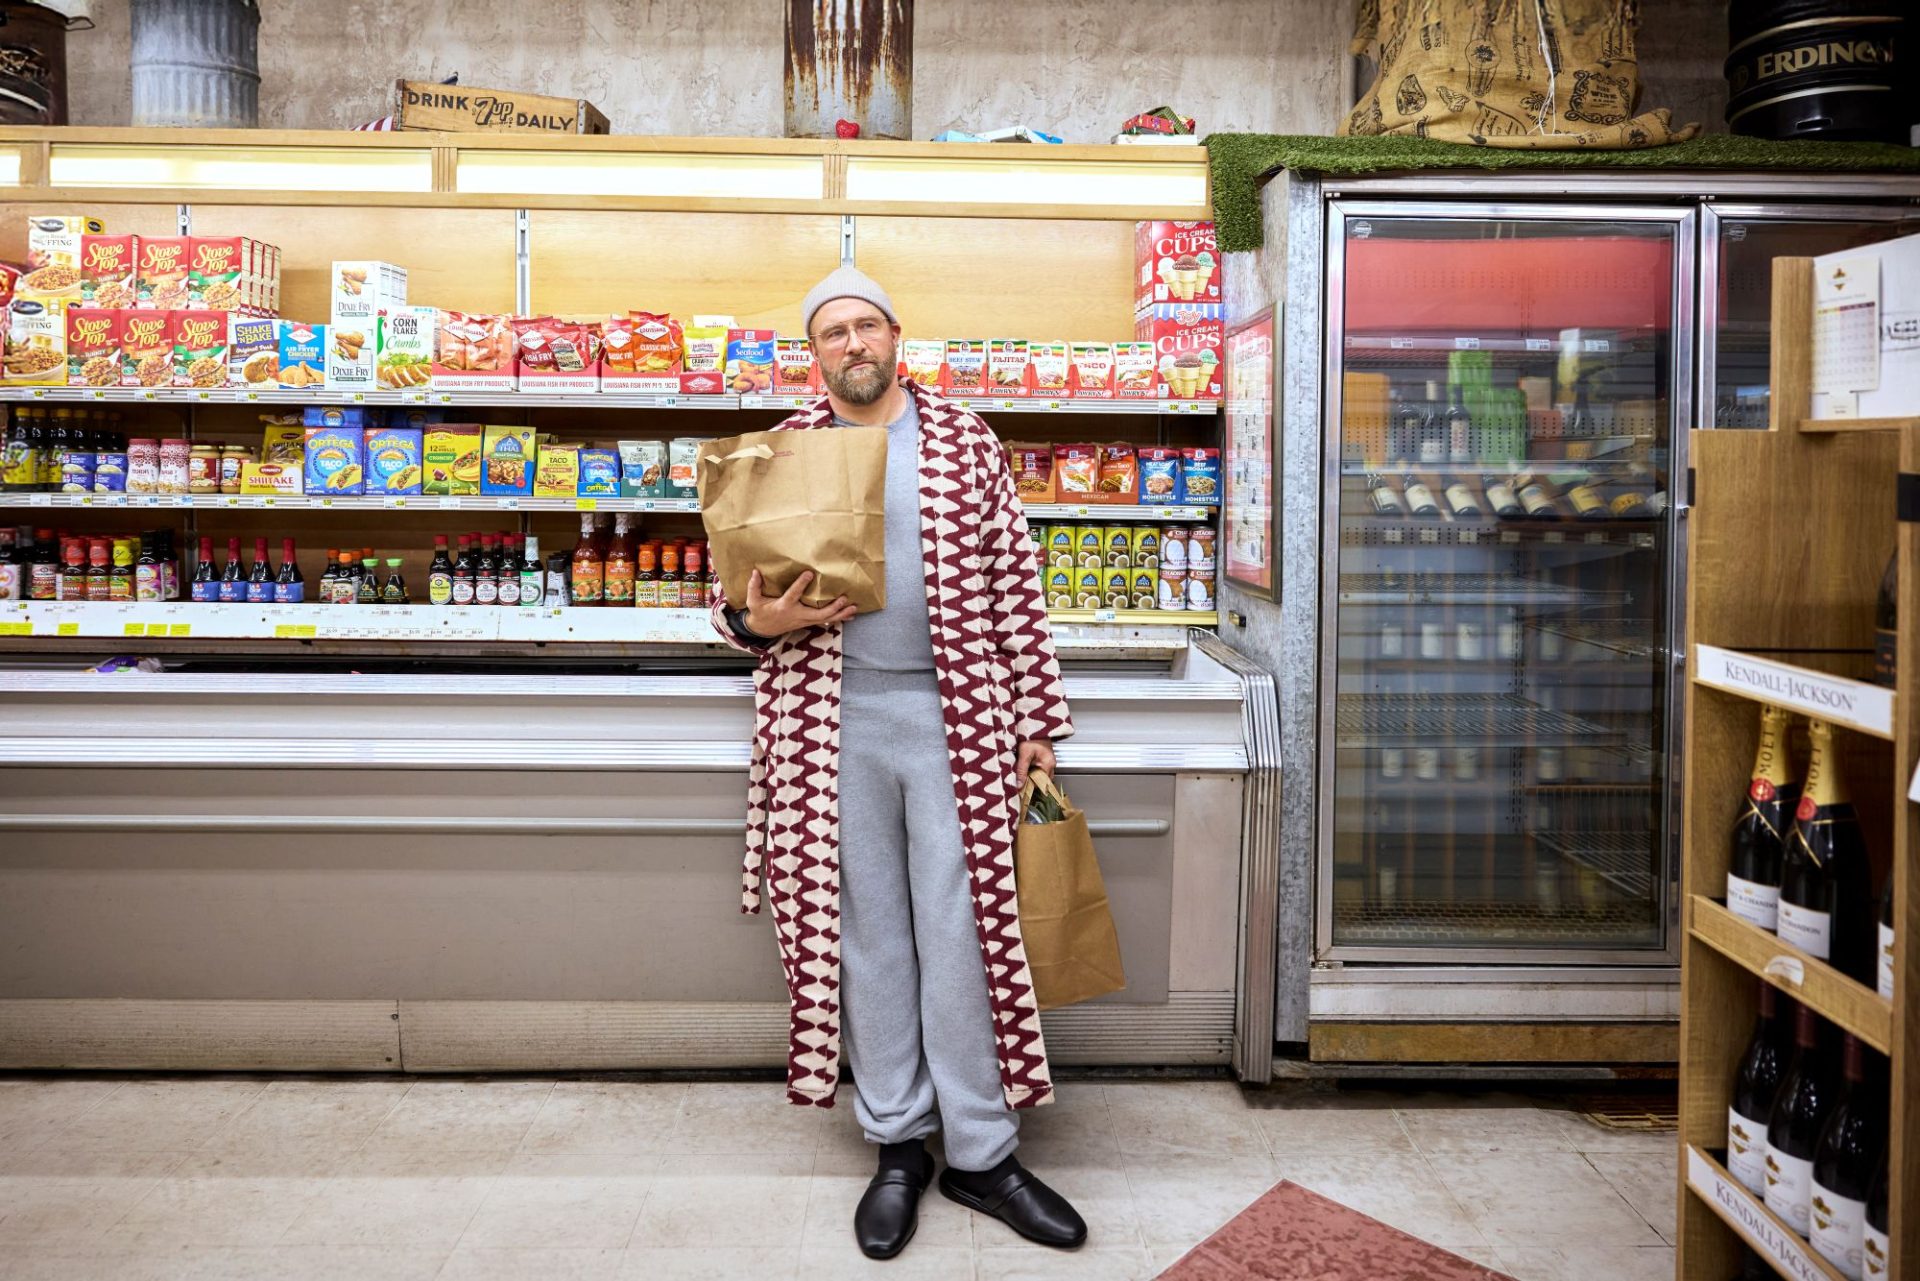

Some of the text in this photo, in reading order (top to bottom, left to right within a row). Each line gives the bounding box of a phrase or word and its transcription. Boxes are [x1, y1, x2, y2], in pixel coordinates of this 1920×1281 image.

[1756, 38, 1894, 80] ERDING
[407, 91, 469, 110] DRINK
[516, 112, 574, 131] DAILY
[1156, 235, 1218, 256] CUPS
[84, 243, 125, 267] Stove
[141, 244, 182, 268] Stove
[193, 244, 235, 268] Stove
[98, 257, 119, 272] Top
[155, 258, 176, 273] Top
[207, 258, 228, 273] Top
[338, 301, 372, 312] DIXIE FRY
[70, 318, 112, 342] Stove
[236, 324, 272, 336] SHAKE
[393, 318, 418, 327] CORN
[1190, 325, 1219, 335] CREAM
[124, 318, 165, 343] Stove
[177, 318, 219, 343] Stove
[393, 327, 418, 335] FLAKES
[85, 332, 106, 347] Top
[139, 333, 159, 348] Top
[193, 333, 213, 348] Top
[245, 333, 272, 344] BAKE
[386, 336, 422, 350] Crumbs
[1157, 333, 1222, 354] CUPS
[540, 352, 552, 361] FRY
[735, 348, 764, 356] Seafood
[332, 365, 370, 377] DIXIE FRY
[308, 438, 355, 450] ORTEGA
[368, 439, 416, 450] ORTEGA
[320, 459, 343, 468] TACO
[380, 460, 403, 468] TACO
[1725, 661, 1853, 712] KENDALL-JACKSON
